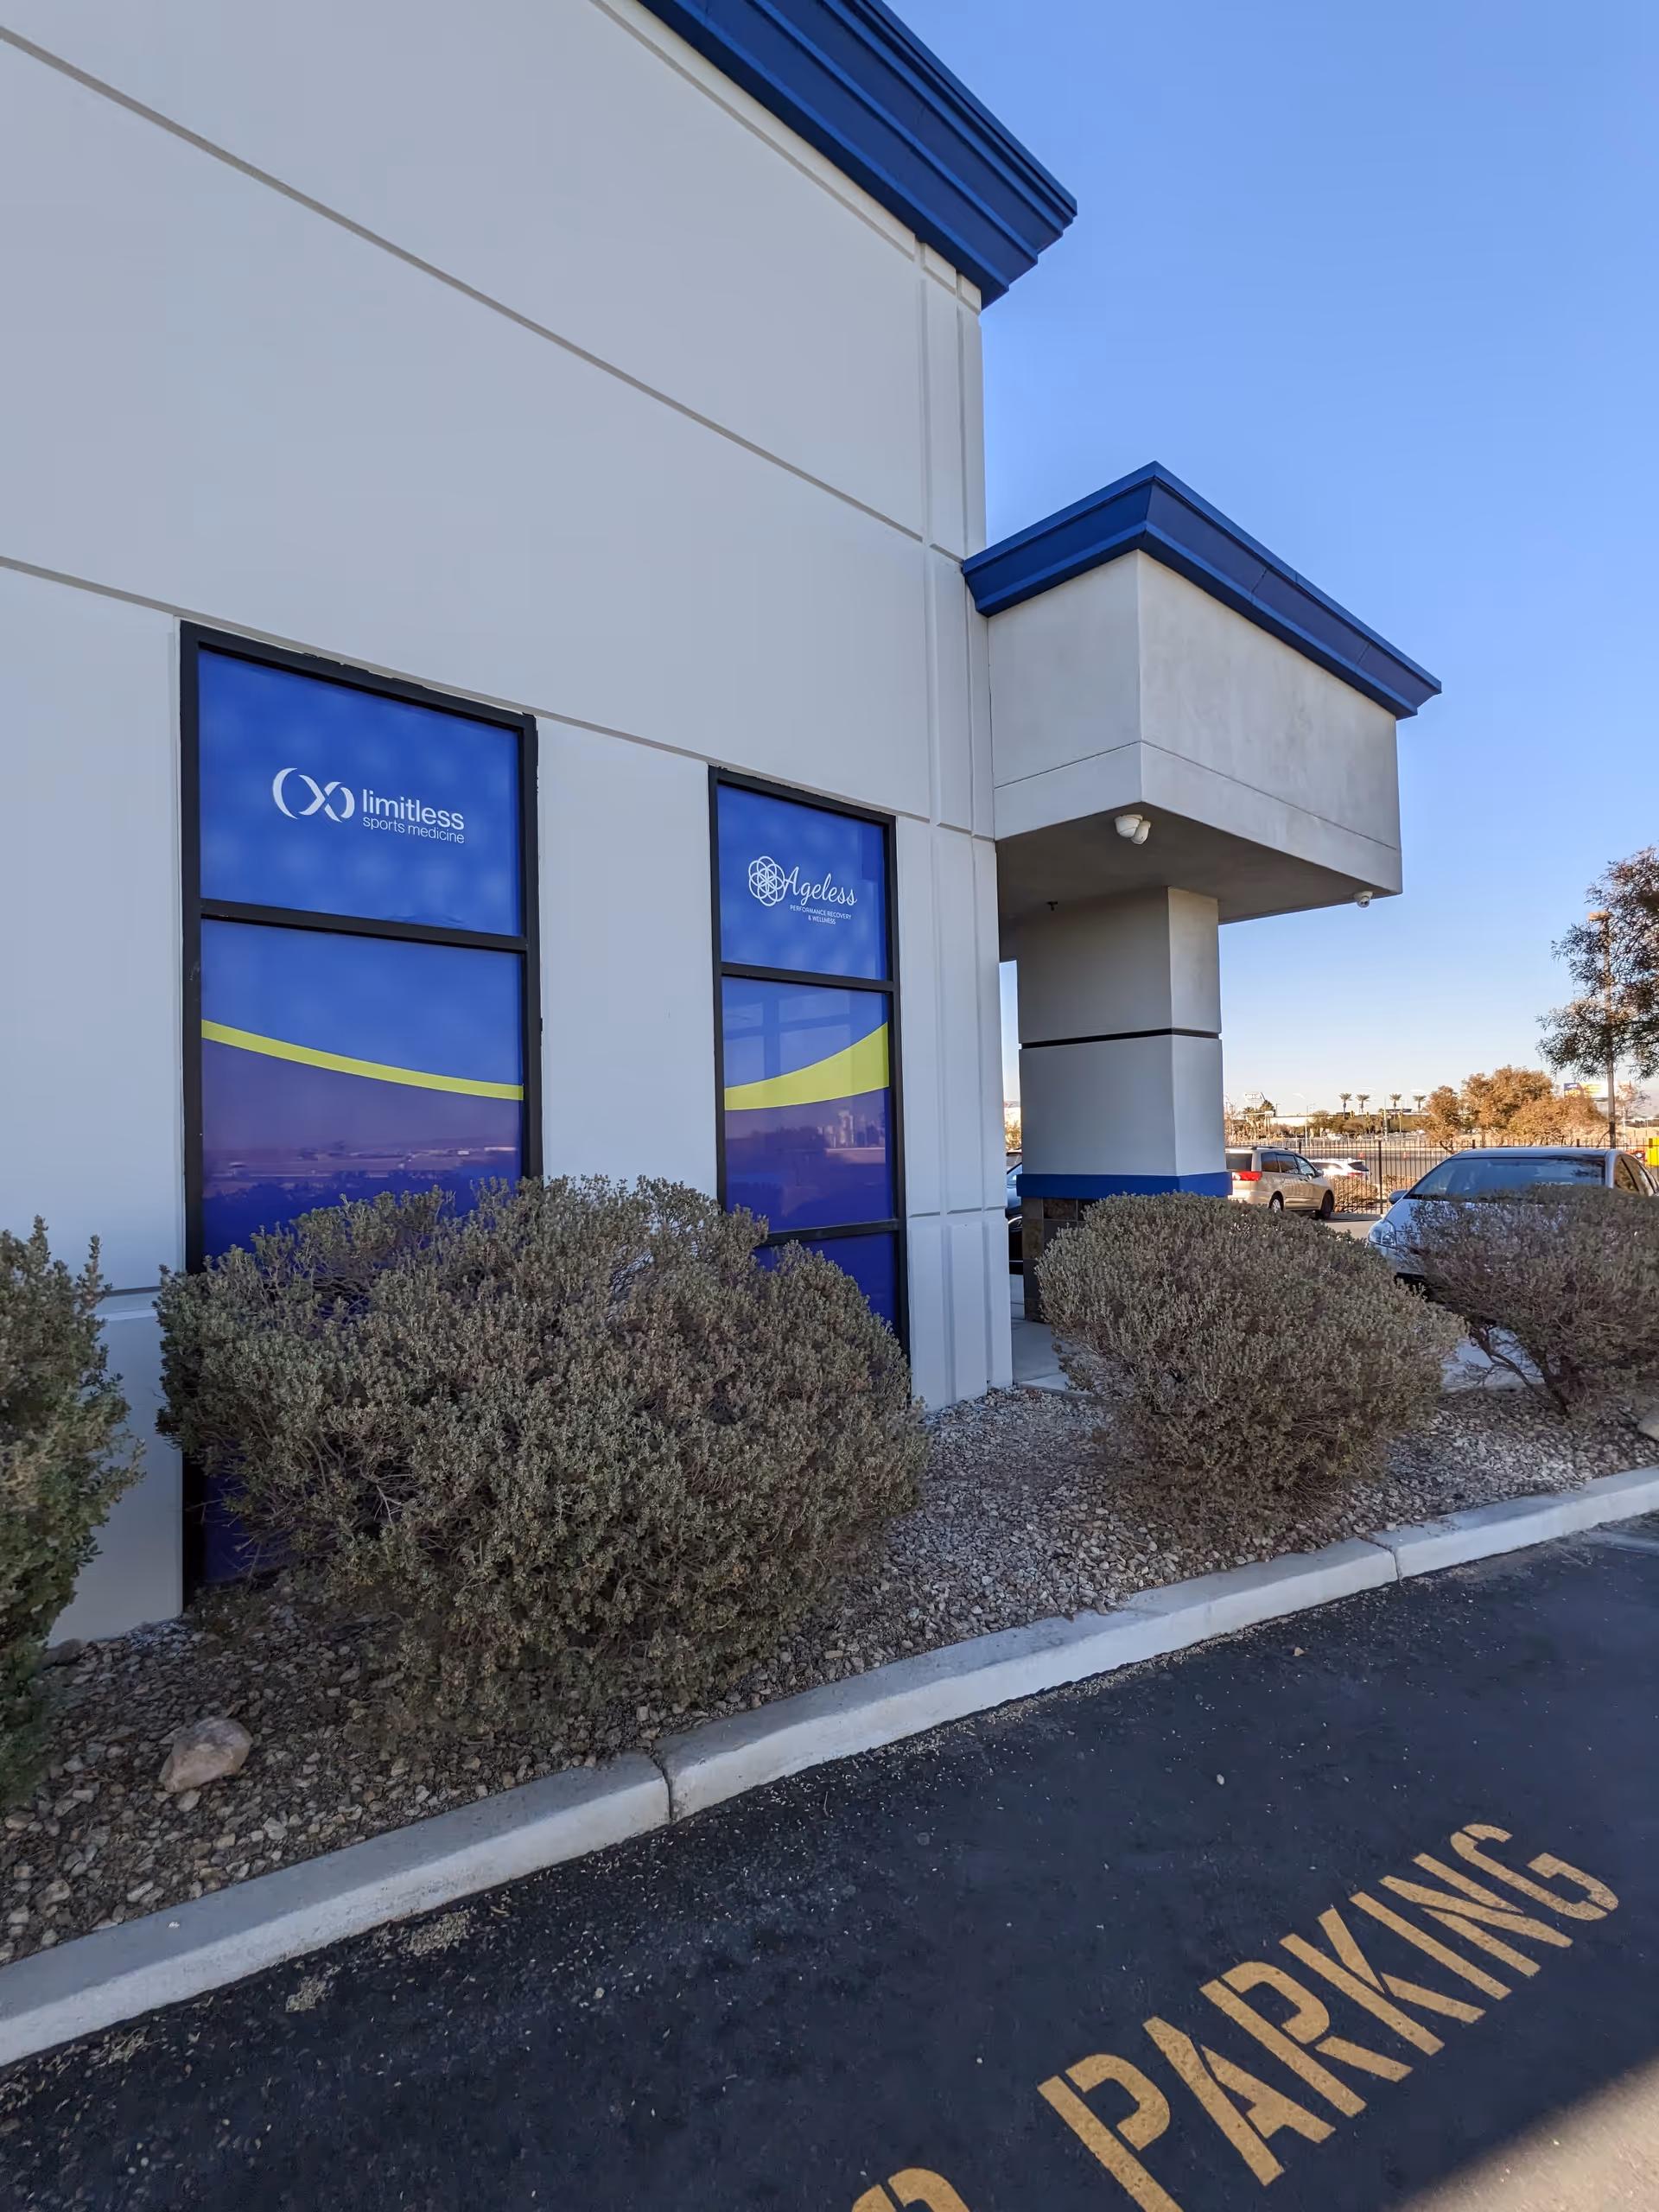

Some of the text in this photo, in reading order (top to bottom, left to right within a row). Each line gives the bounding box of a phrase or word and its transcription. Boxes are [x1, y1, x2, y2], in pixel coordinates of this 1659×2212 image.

[363, 789, 465, 830] limitless
[363, 817, 465, 844] sports medicine
[784, 867, 857, 906] Ageless
[790, 905, 852, 920] PERFORMANCE RECOVERY
[812, 916, 836, 925] WELLNESS
[1038, 1824, 1619, 2212] PARKING
